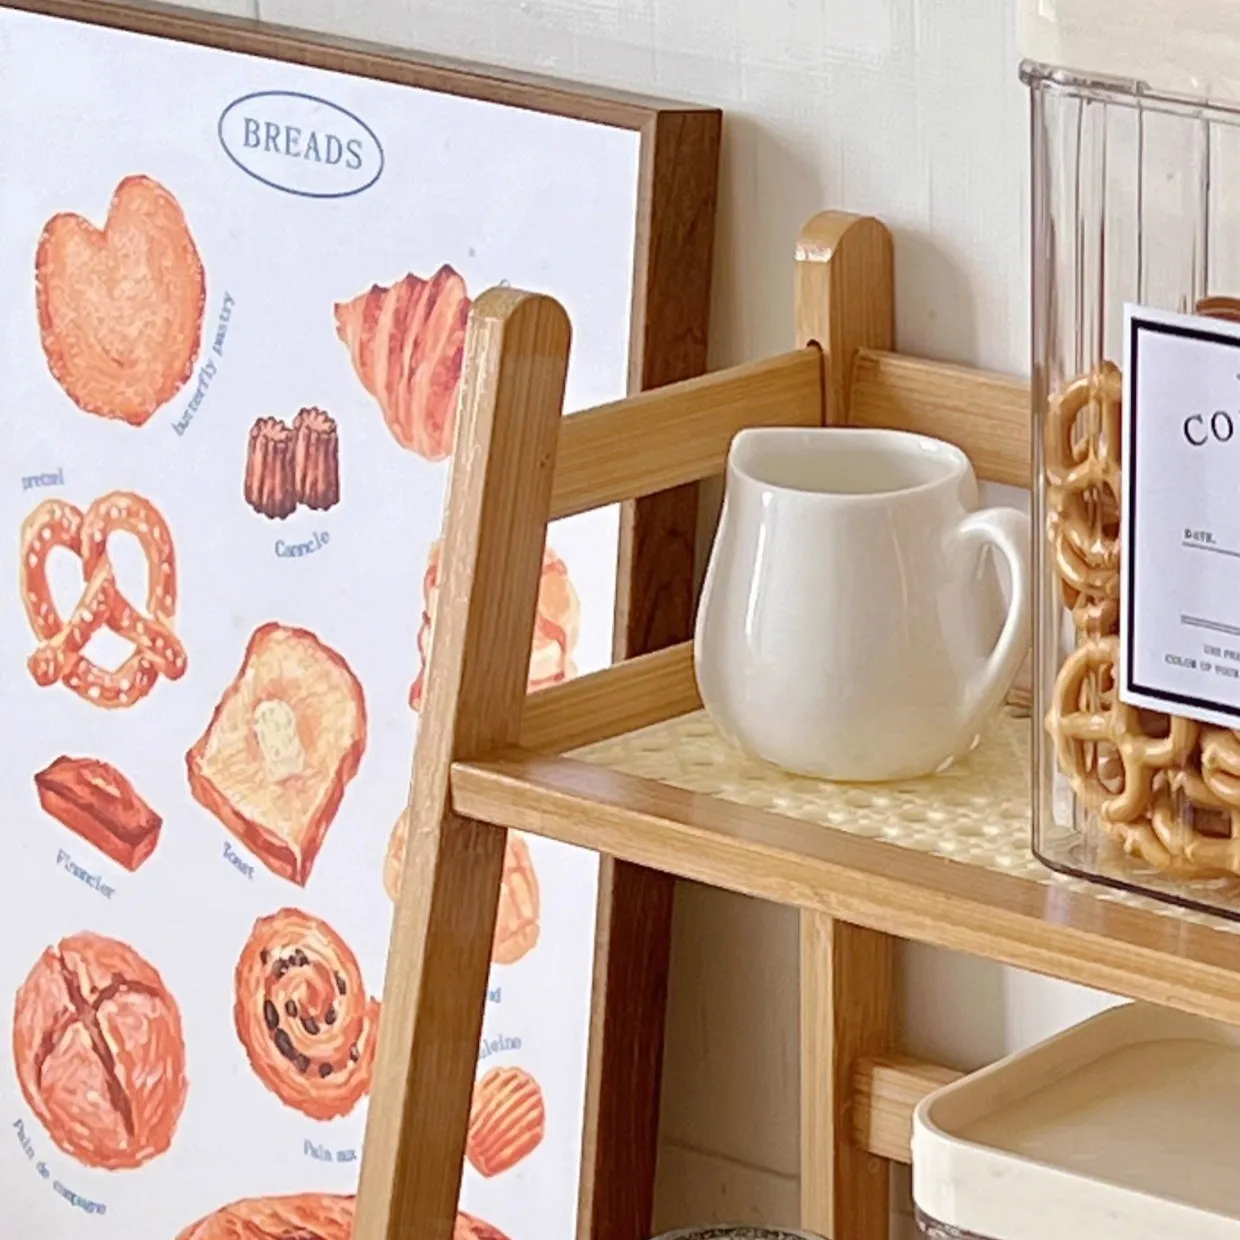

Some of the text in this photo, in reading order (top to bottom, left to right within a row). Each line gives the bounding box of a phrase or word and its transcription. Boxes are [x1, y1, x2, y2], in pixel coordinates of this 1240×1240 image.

[243, 117, 363, 170] BREADS
[172, 290, 236, 437] butterfly pastry
